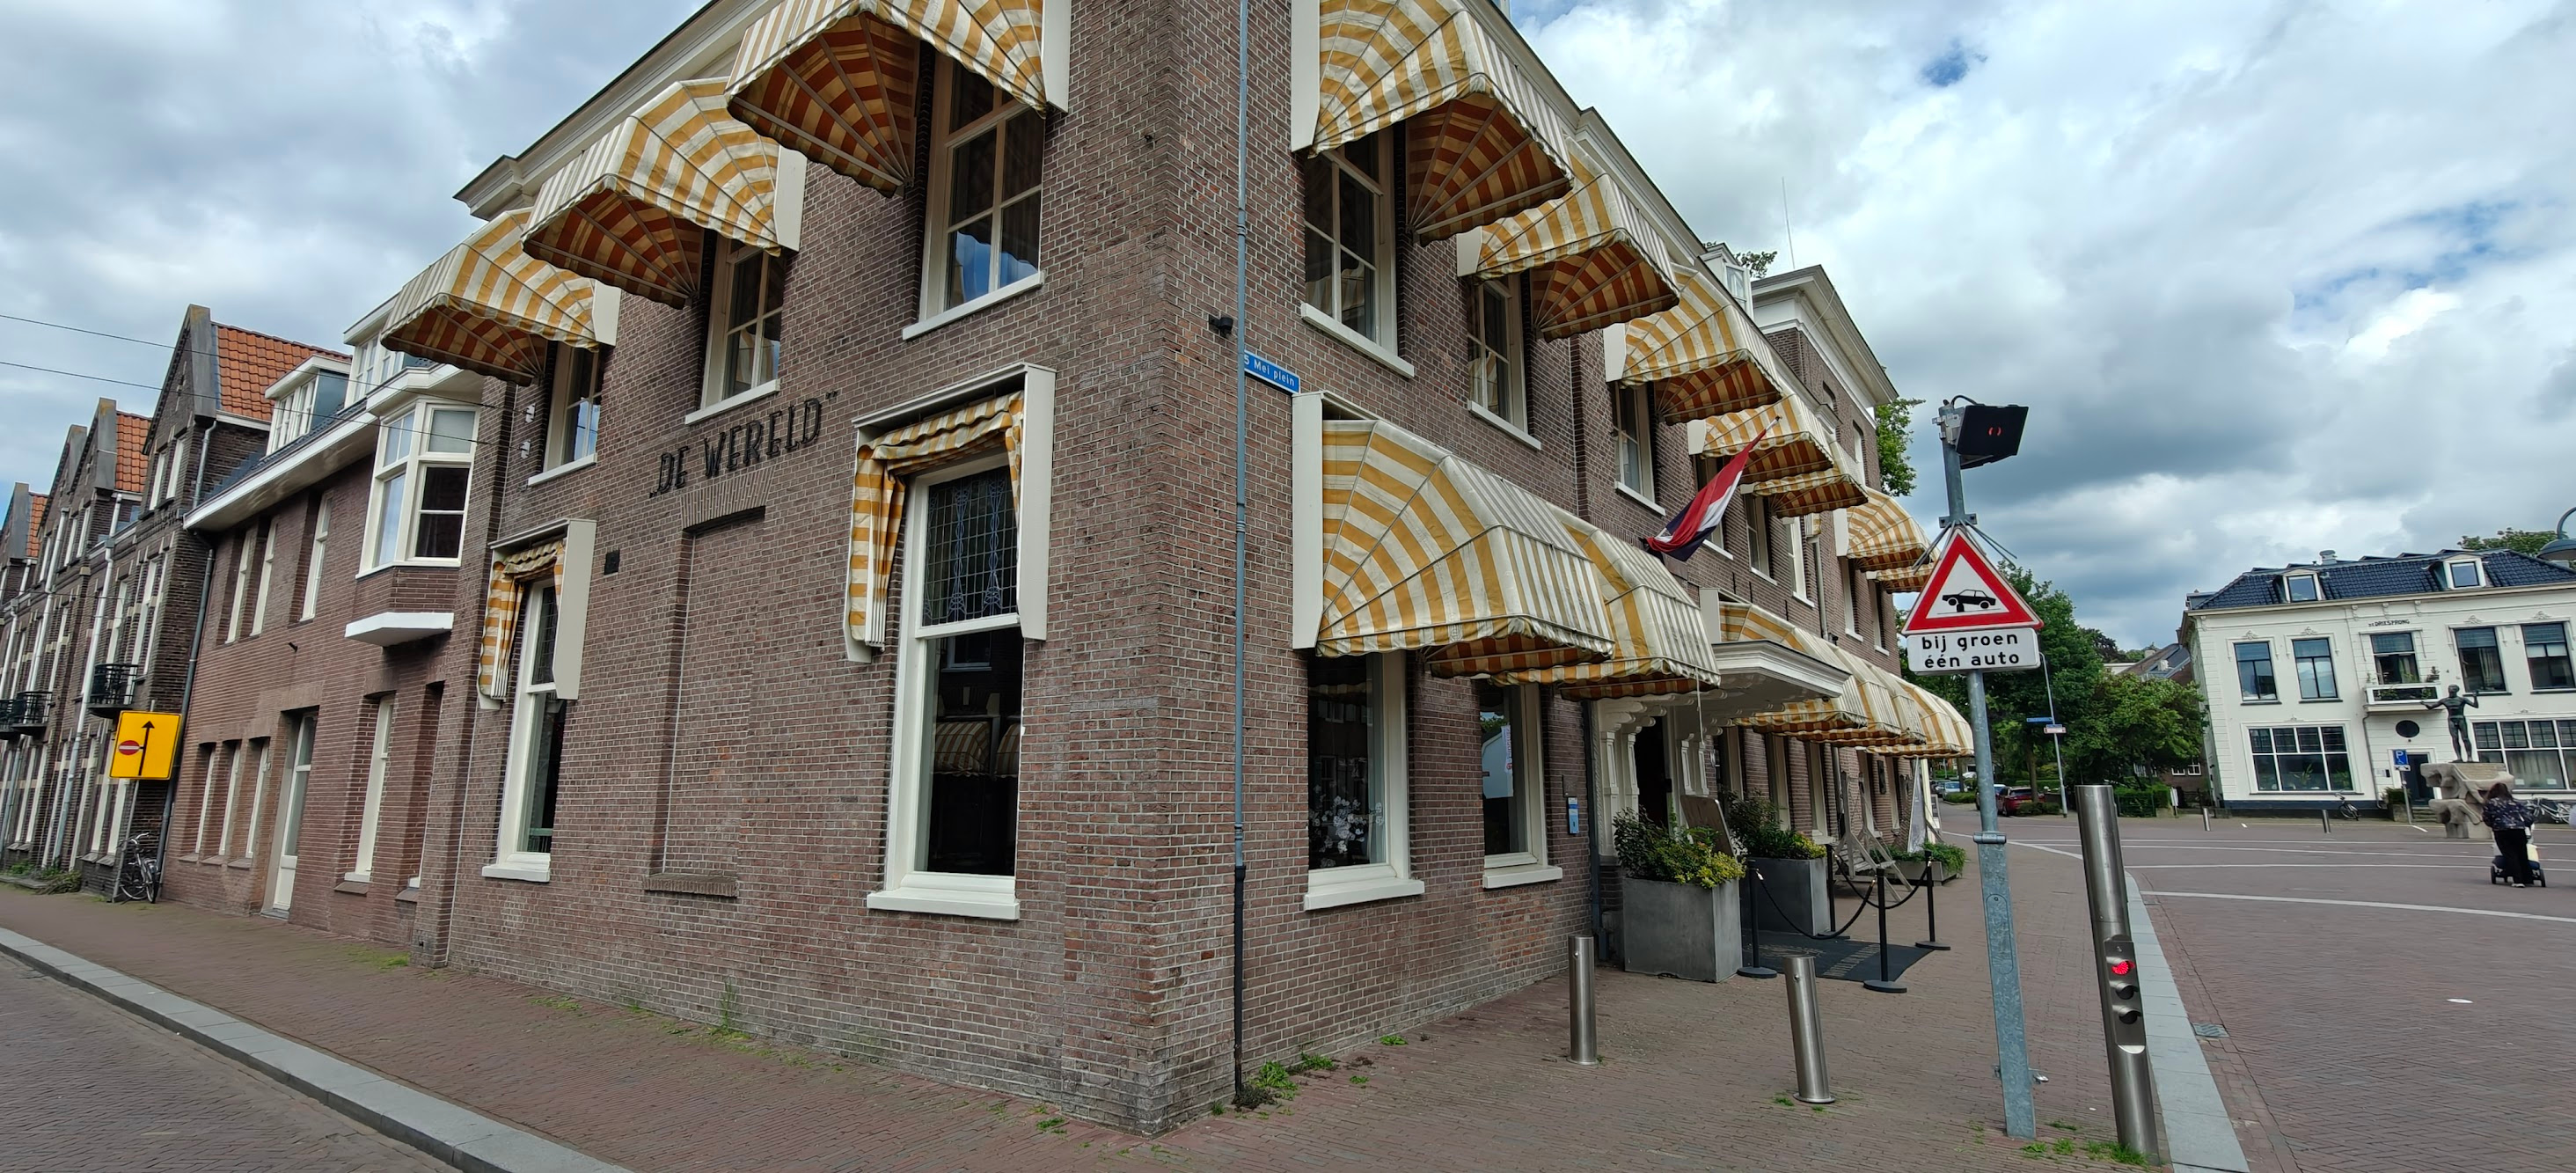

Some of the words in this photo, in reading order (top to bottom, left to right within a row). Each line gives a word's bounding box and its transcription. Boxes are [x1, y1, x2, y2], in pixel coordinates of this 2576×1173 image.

[1254, 359, 1270, 375] Mei
[1273, 370, 1295, 387] plein
[1922, 635, 1946, 653] bij
[1958, 634, 2018, 651] groen
[1924, 655, 1960, 668] één
[1972, 652, 2020, 666] auto
